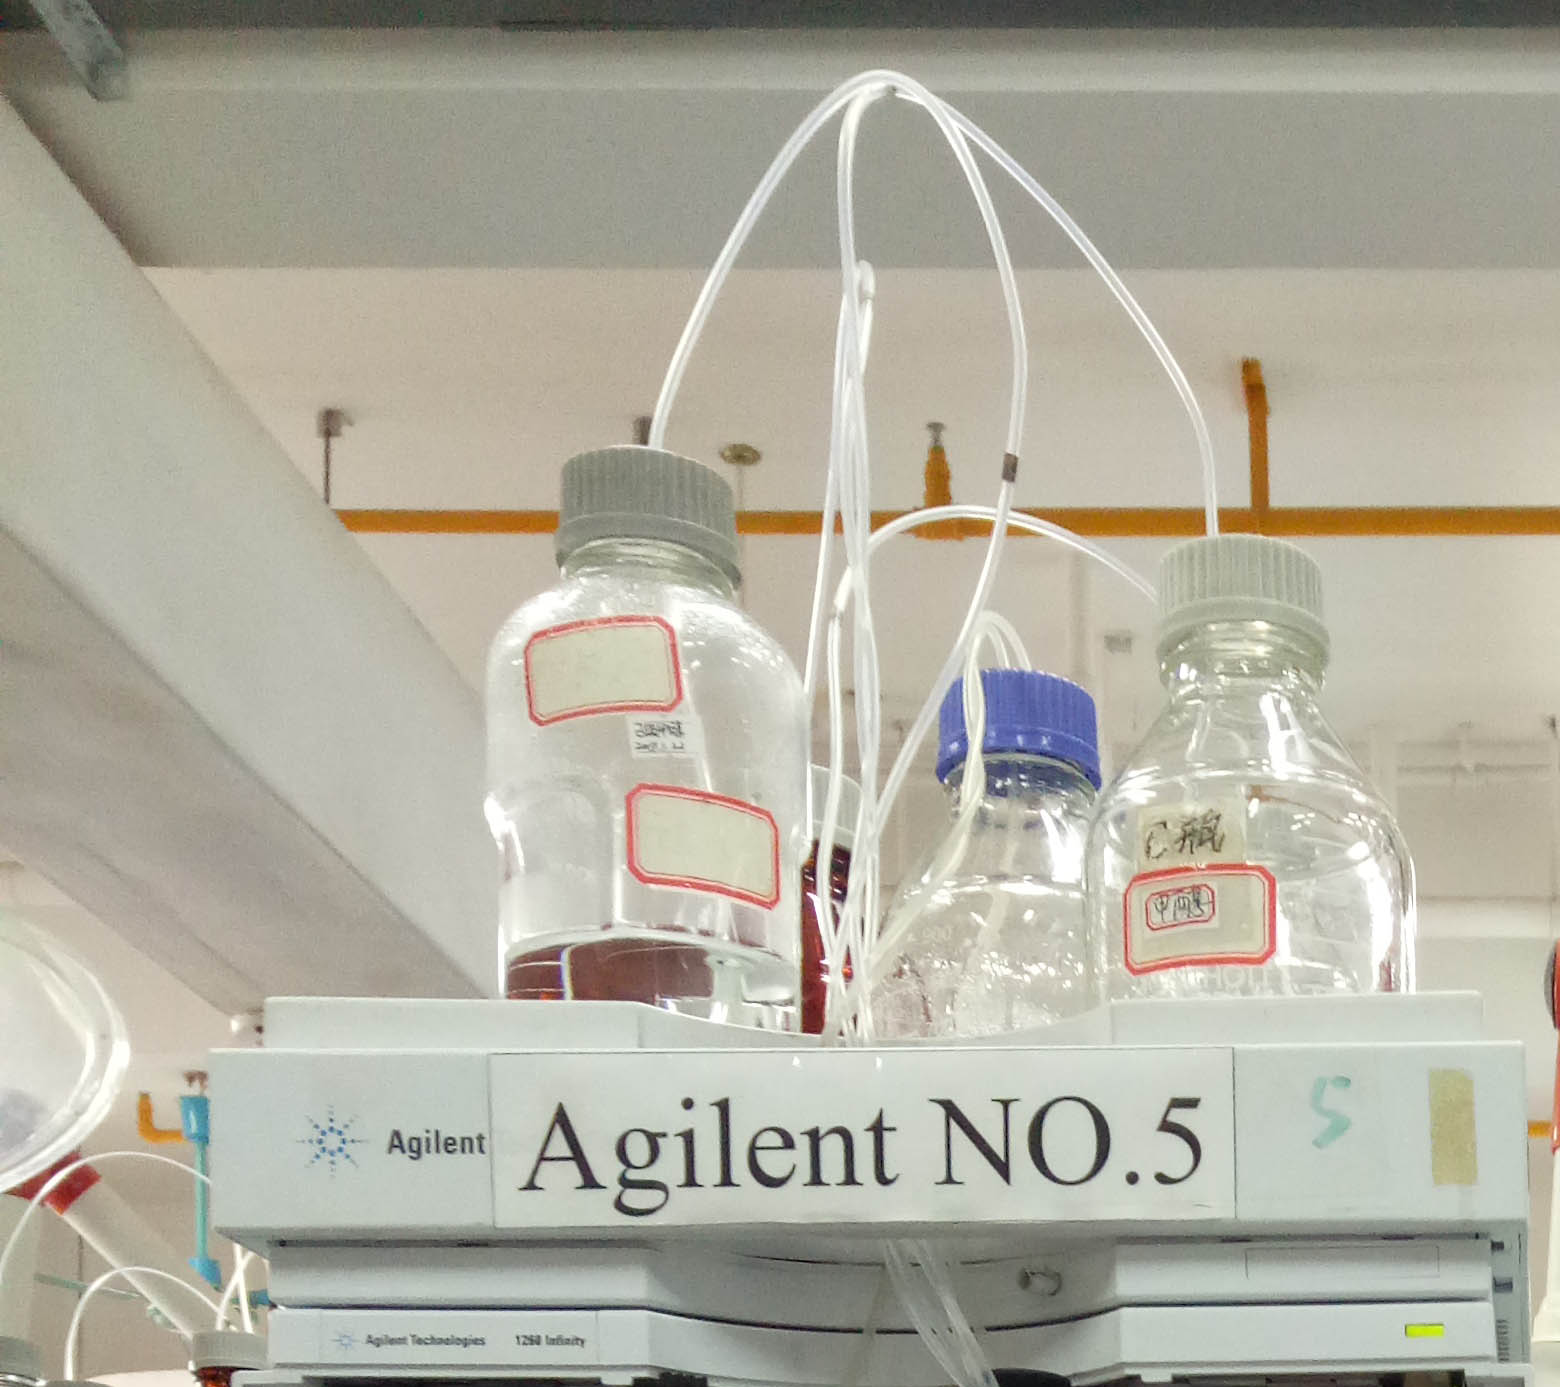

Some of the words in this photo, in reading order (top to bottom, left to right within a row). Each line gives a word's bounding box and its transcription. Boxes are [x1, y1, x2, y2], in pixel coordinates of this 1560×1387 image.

[387, 1130, 486, 1161] Agilent
[517, 1096, 902, 1217] Agilent
[927, 1095, 1203, 1187] NO.5
[365, 1334, 408, 1349] Agilent
[411, 1334, 486, 1349] Technologies
[544, 1334, 586, 1349] Infinity
